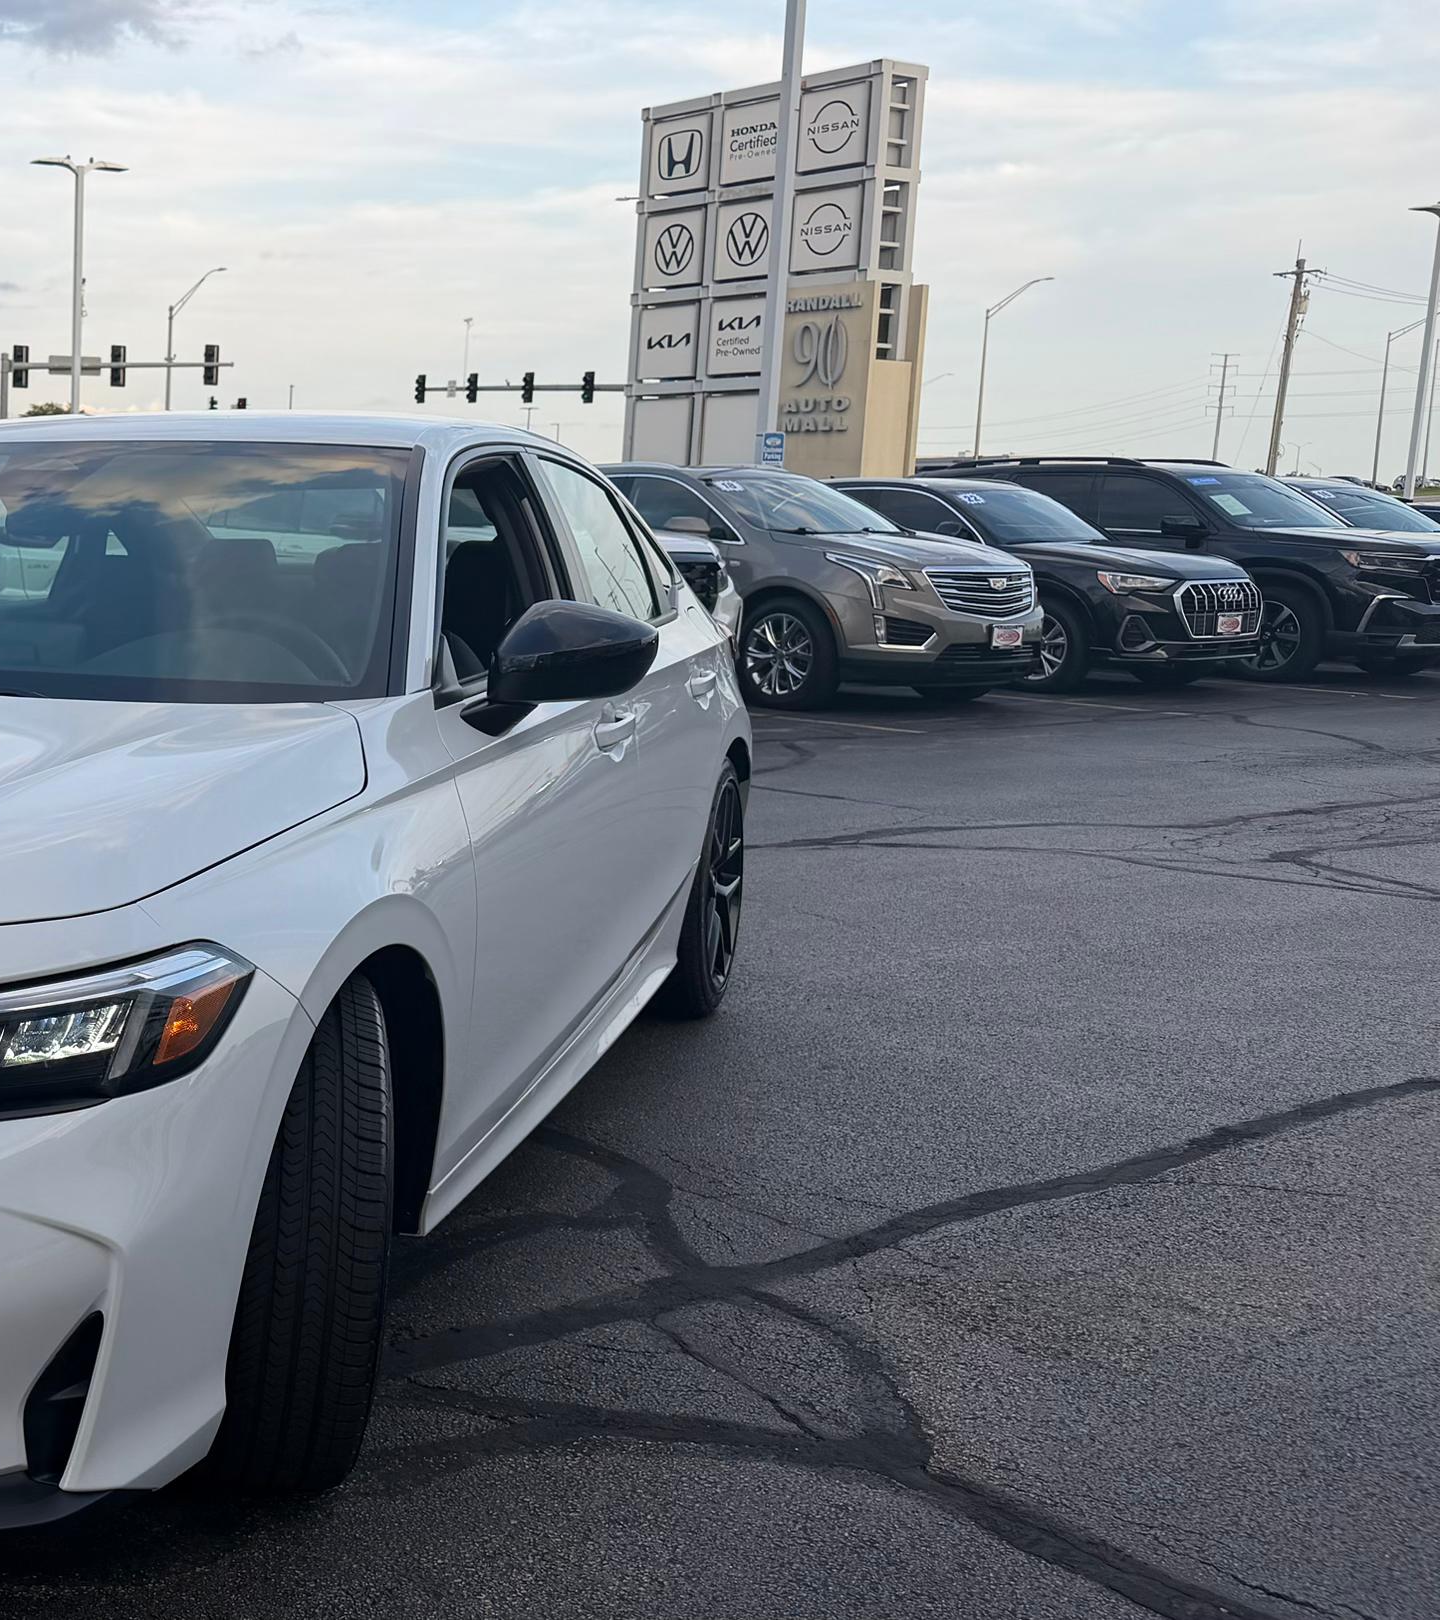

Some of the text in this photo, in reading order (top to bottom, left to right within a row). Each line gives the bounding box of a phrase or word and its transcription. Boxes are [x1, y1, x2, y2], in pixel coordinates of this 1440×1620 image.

[731, 121, 777, 137] HONDA
[807, 118, 859, 136] NISSAN
[729, 132, 777, 153] Certified
[729, 147, 777, 161] Pre-Owned
[800, 221, 852, 237] NISSAN
[787, 293, 862, 312] RANDALL
[718, 315, 761, 331] KIA
[647, 333, 691, 350] KIA
[716, 336, 750, 347] Certified
[715, 346, 760, 357] Pre-Owned
[794, 313, 848, 390] 90
[783, 397, 850, 413] AUTO
[782, 416, 848, 433] MALL
